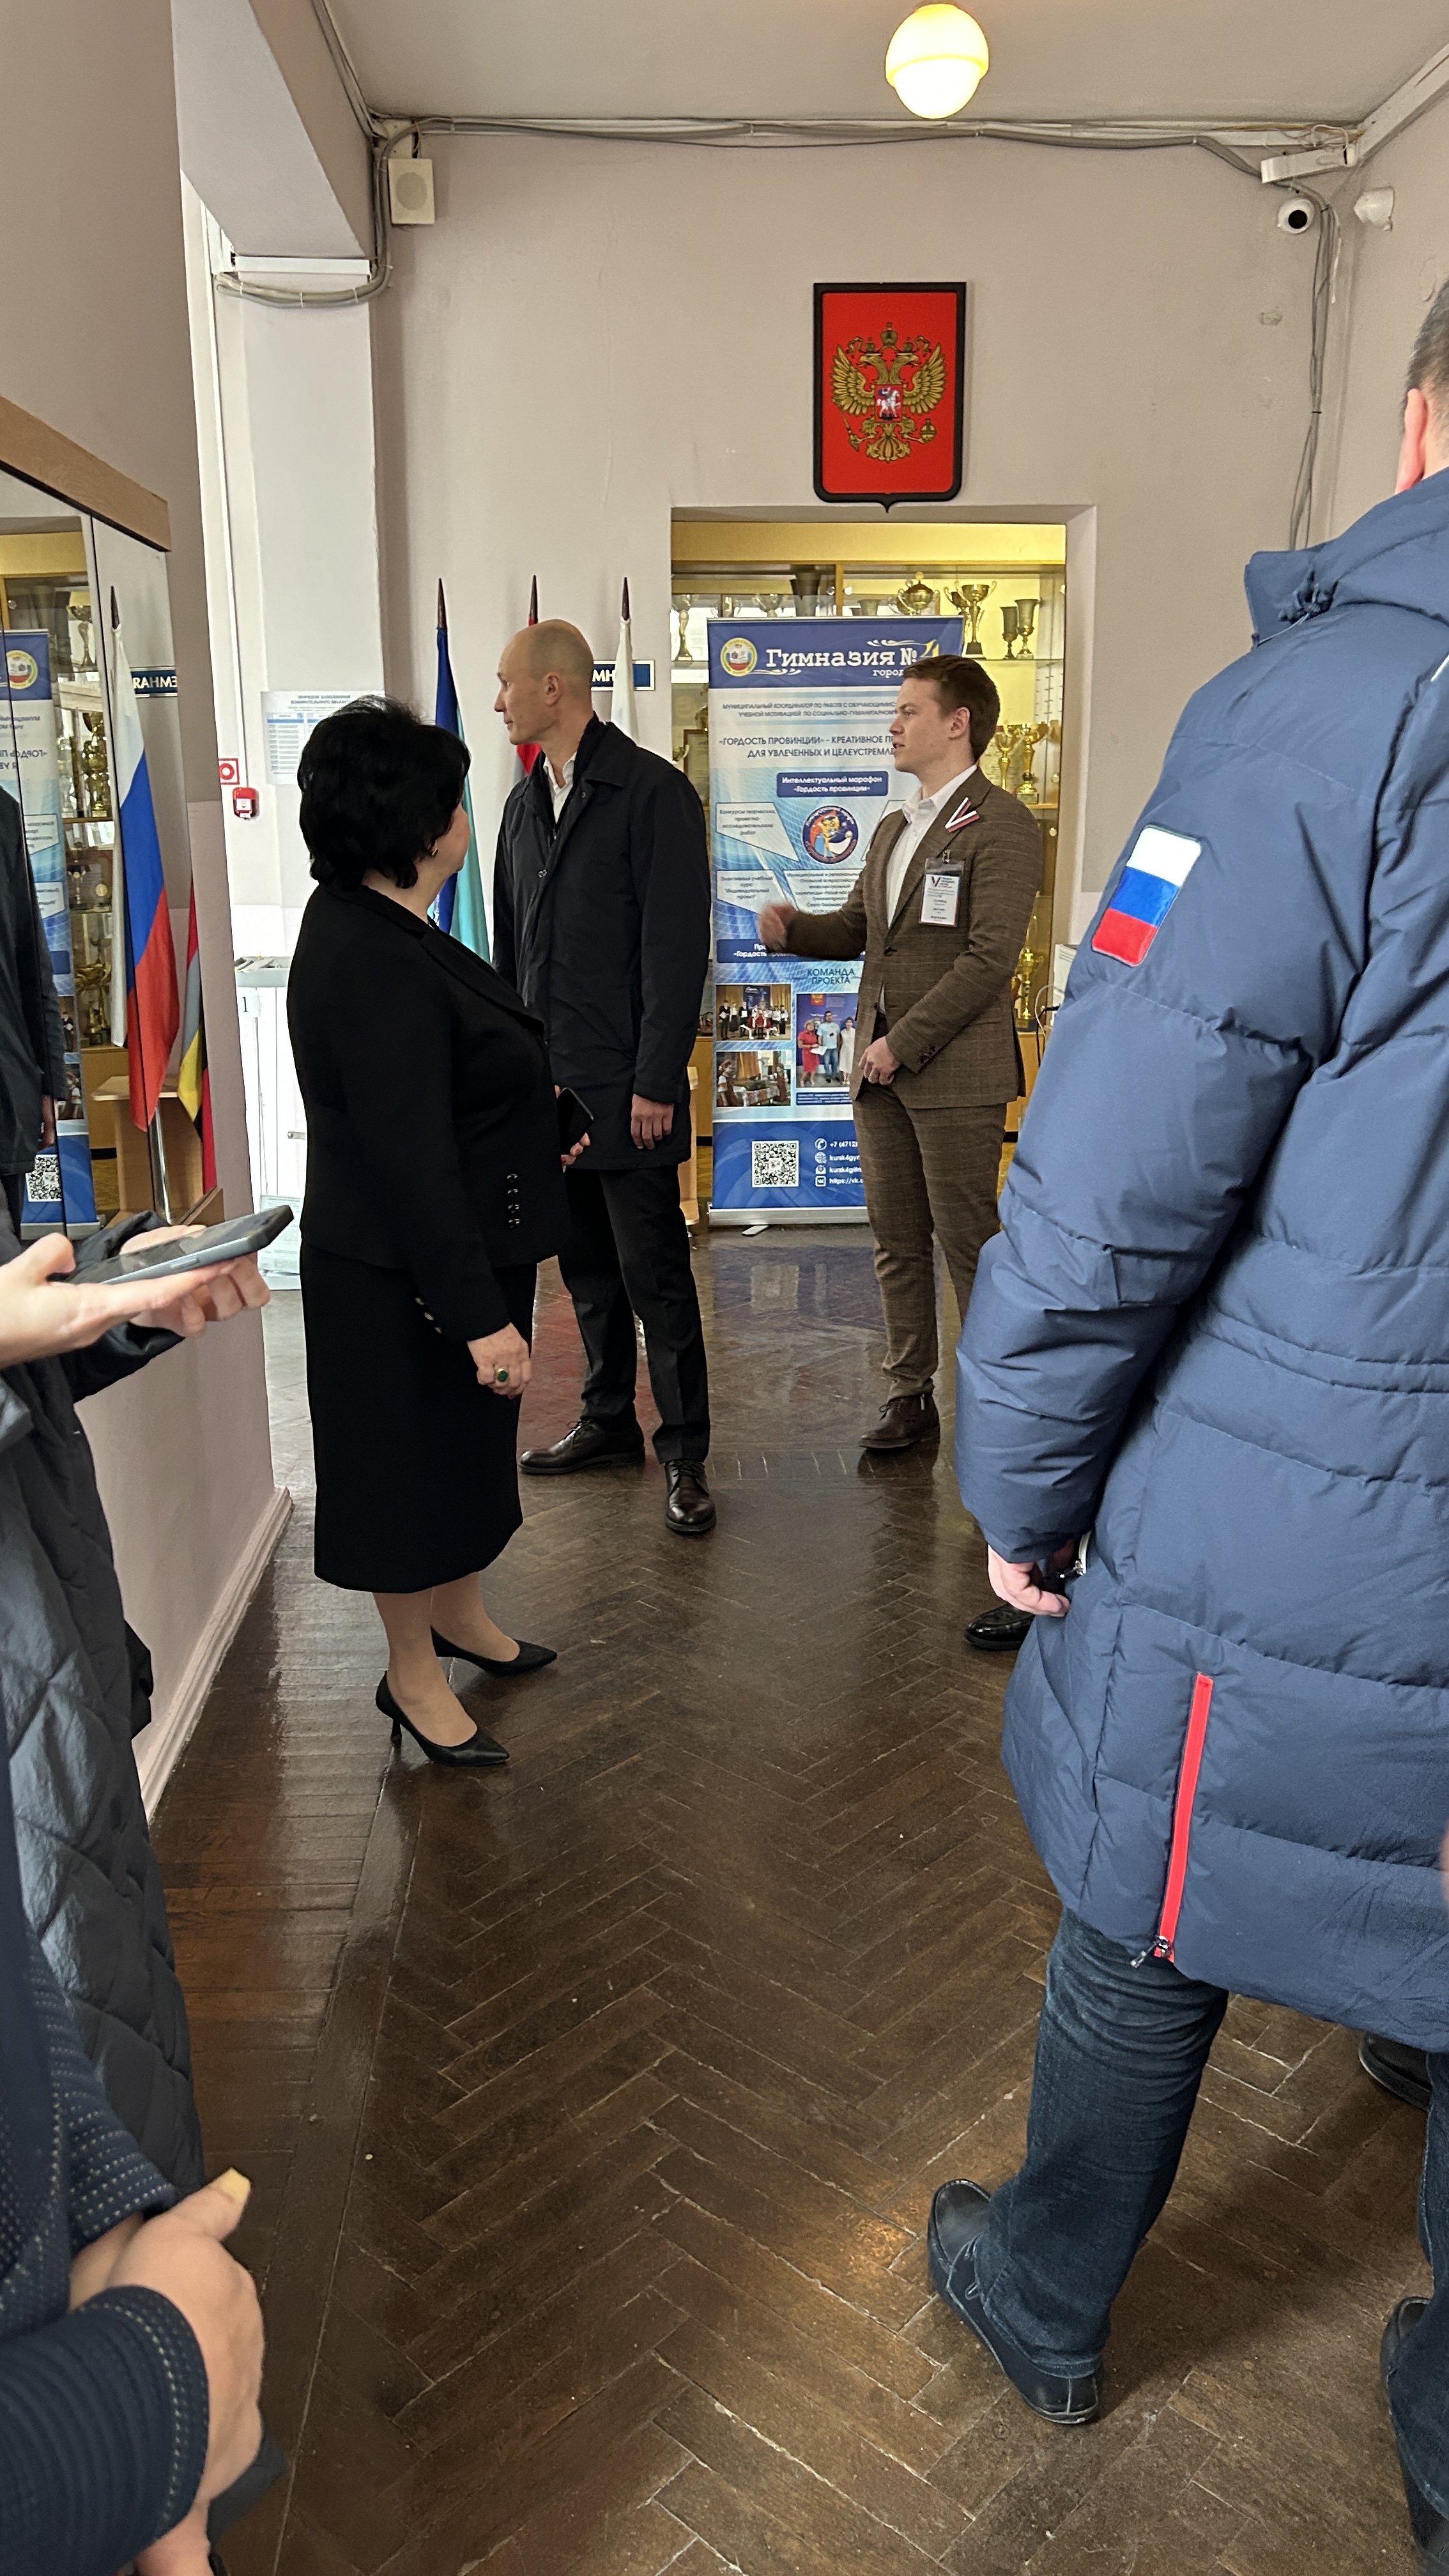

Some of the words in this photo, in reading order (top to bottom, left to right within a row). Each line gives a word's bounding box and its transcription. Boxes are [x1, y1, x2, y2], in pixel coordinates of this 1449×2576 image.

[765, 648, 896, 668] Гимназия
[900, 647, 917, 666] №
[831, 735, 883, 744] КРЕАТИВНОЕ
[747, 749, 766, 758] ДЛЯ
[768, 748, 822, 758] УВЛЕЧЕННЫХ
[824, 748, 830, 756] И
[781, 776, 847, 785] Интеллектуальный
[848, 775, 882, 784] марафон
[807, 967, 855, 976] КОМАНДА
[811, 976, 850, 985] ПРОЕКТА
[242, 996, 249, 1013] 1
